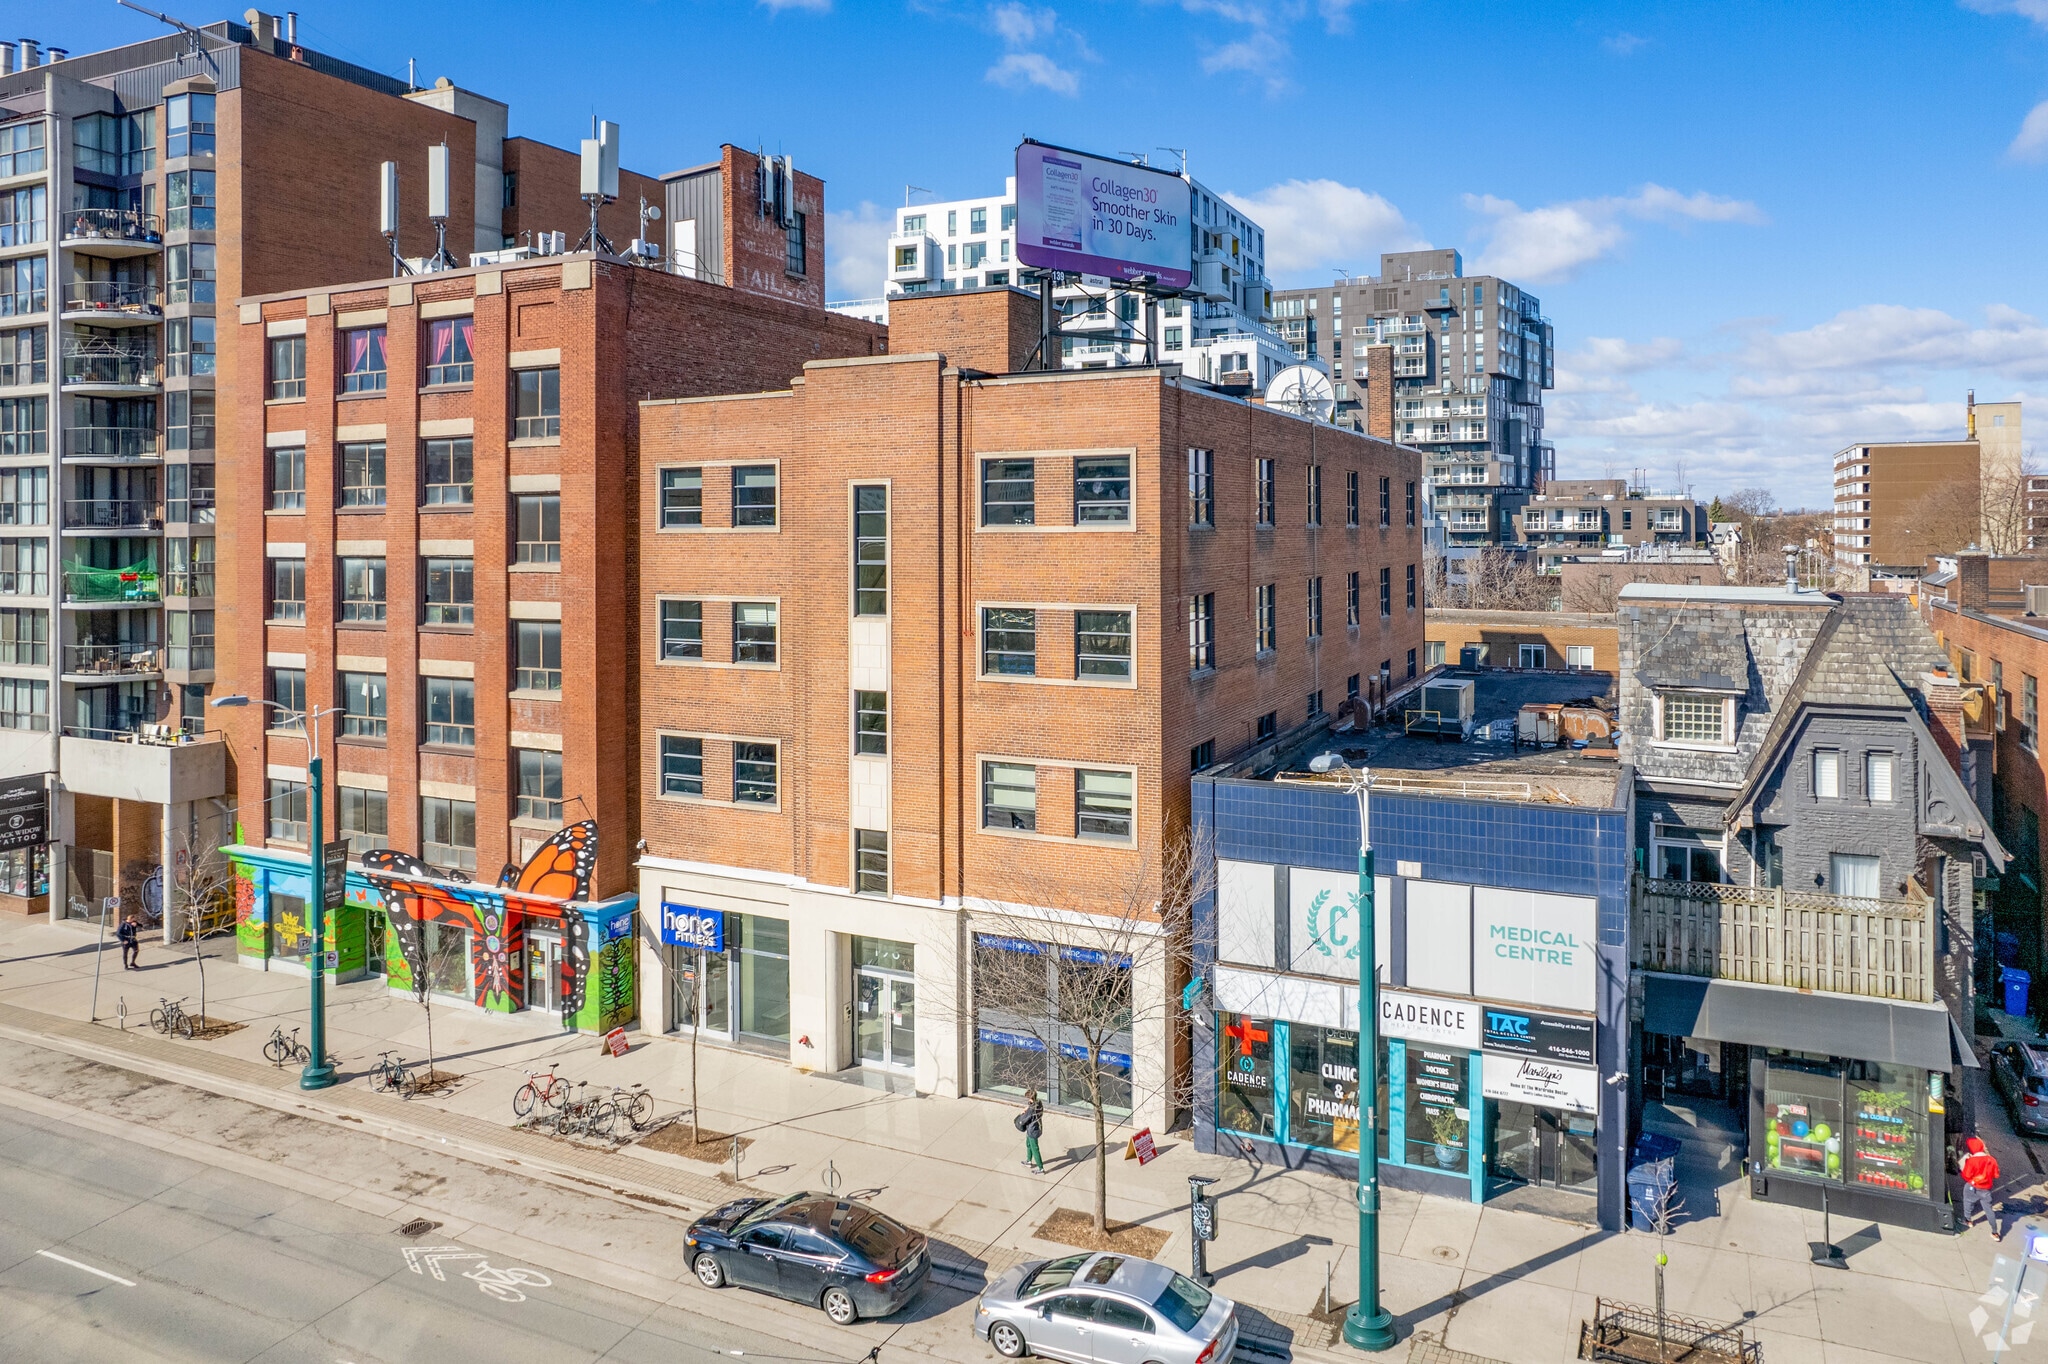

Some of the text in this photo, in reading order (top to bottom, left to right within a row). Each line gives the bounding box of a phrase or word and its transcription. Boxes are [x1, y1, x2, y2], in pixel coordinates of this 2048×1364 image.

[1092, 177, 1157, 204] Collagen30
[1092, 197, 1150, 221] Smoother
[1153, 208, 1177, 226] Skin
[1092, 216, 1157, 242] in 30 Days.
[1052, 271, 1065, 281] 139
[1123, 267, 1142, 275] webber
[1089, 277, 1104, 286] astral
[15, 826, 41, 836] WIDOW
[0, 833, 37, 845] ATTOO
[1329, 905, 1349, 947] C
[675, 931, 718, 947] FITNESS
[1490, 924, 1580, 949] MEDICAL
[1495, 944, 1573, 966] CENTRE
[1383, 1001, 1465, 1030] CADENCE
[1487, 1011, 1530, 1035] TAC
[1391, 1022, 1422, 1031] HEALTH
[1484, 1028, 1500, 1036] TOTAL
[1423, 1050, 1452, 1062] PHARMACY
[1548, 1045, 1590, 1056] 416-546-1000
[1321, 1062, 1358, 1082] CLINIC
[1425, 1065, 1450, 1076] DOCTORS
[1227, 1070, 1266, 1087] CADENCE
[1415, 1077, 1459, 1091] WOMEN'S HEALTH
[1334, 1083, 1344, 1099] &
[1535, 1086, 1554, 1094] Wardrobe
[1419, 1092, 1455, 1105] CHIROPRACTIC
[1308, 1097, 1360, 1121] PHARMA
